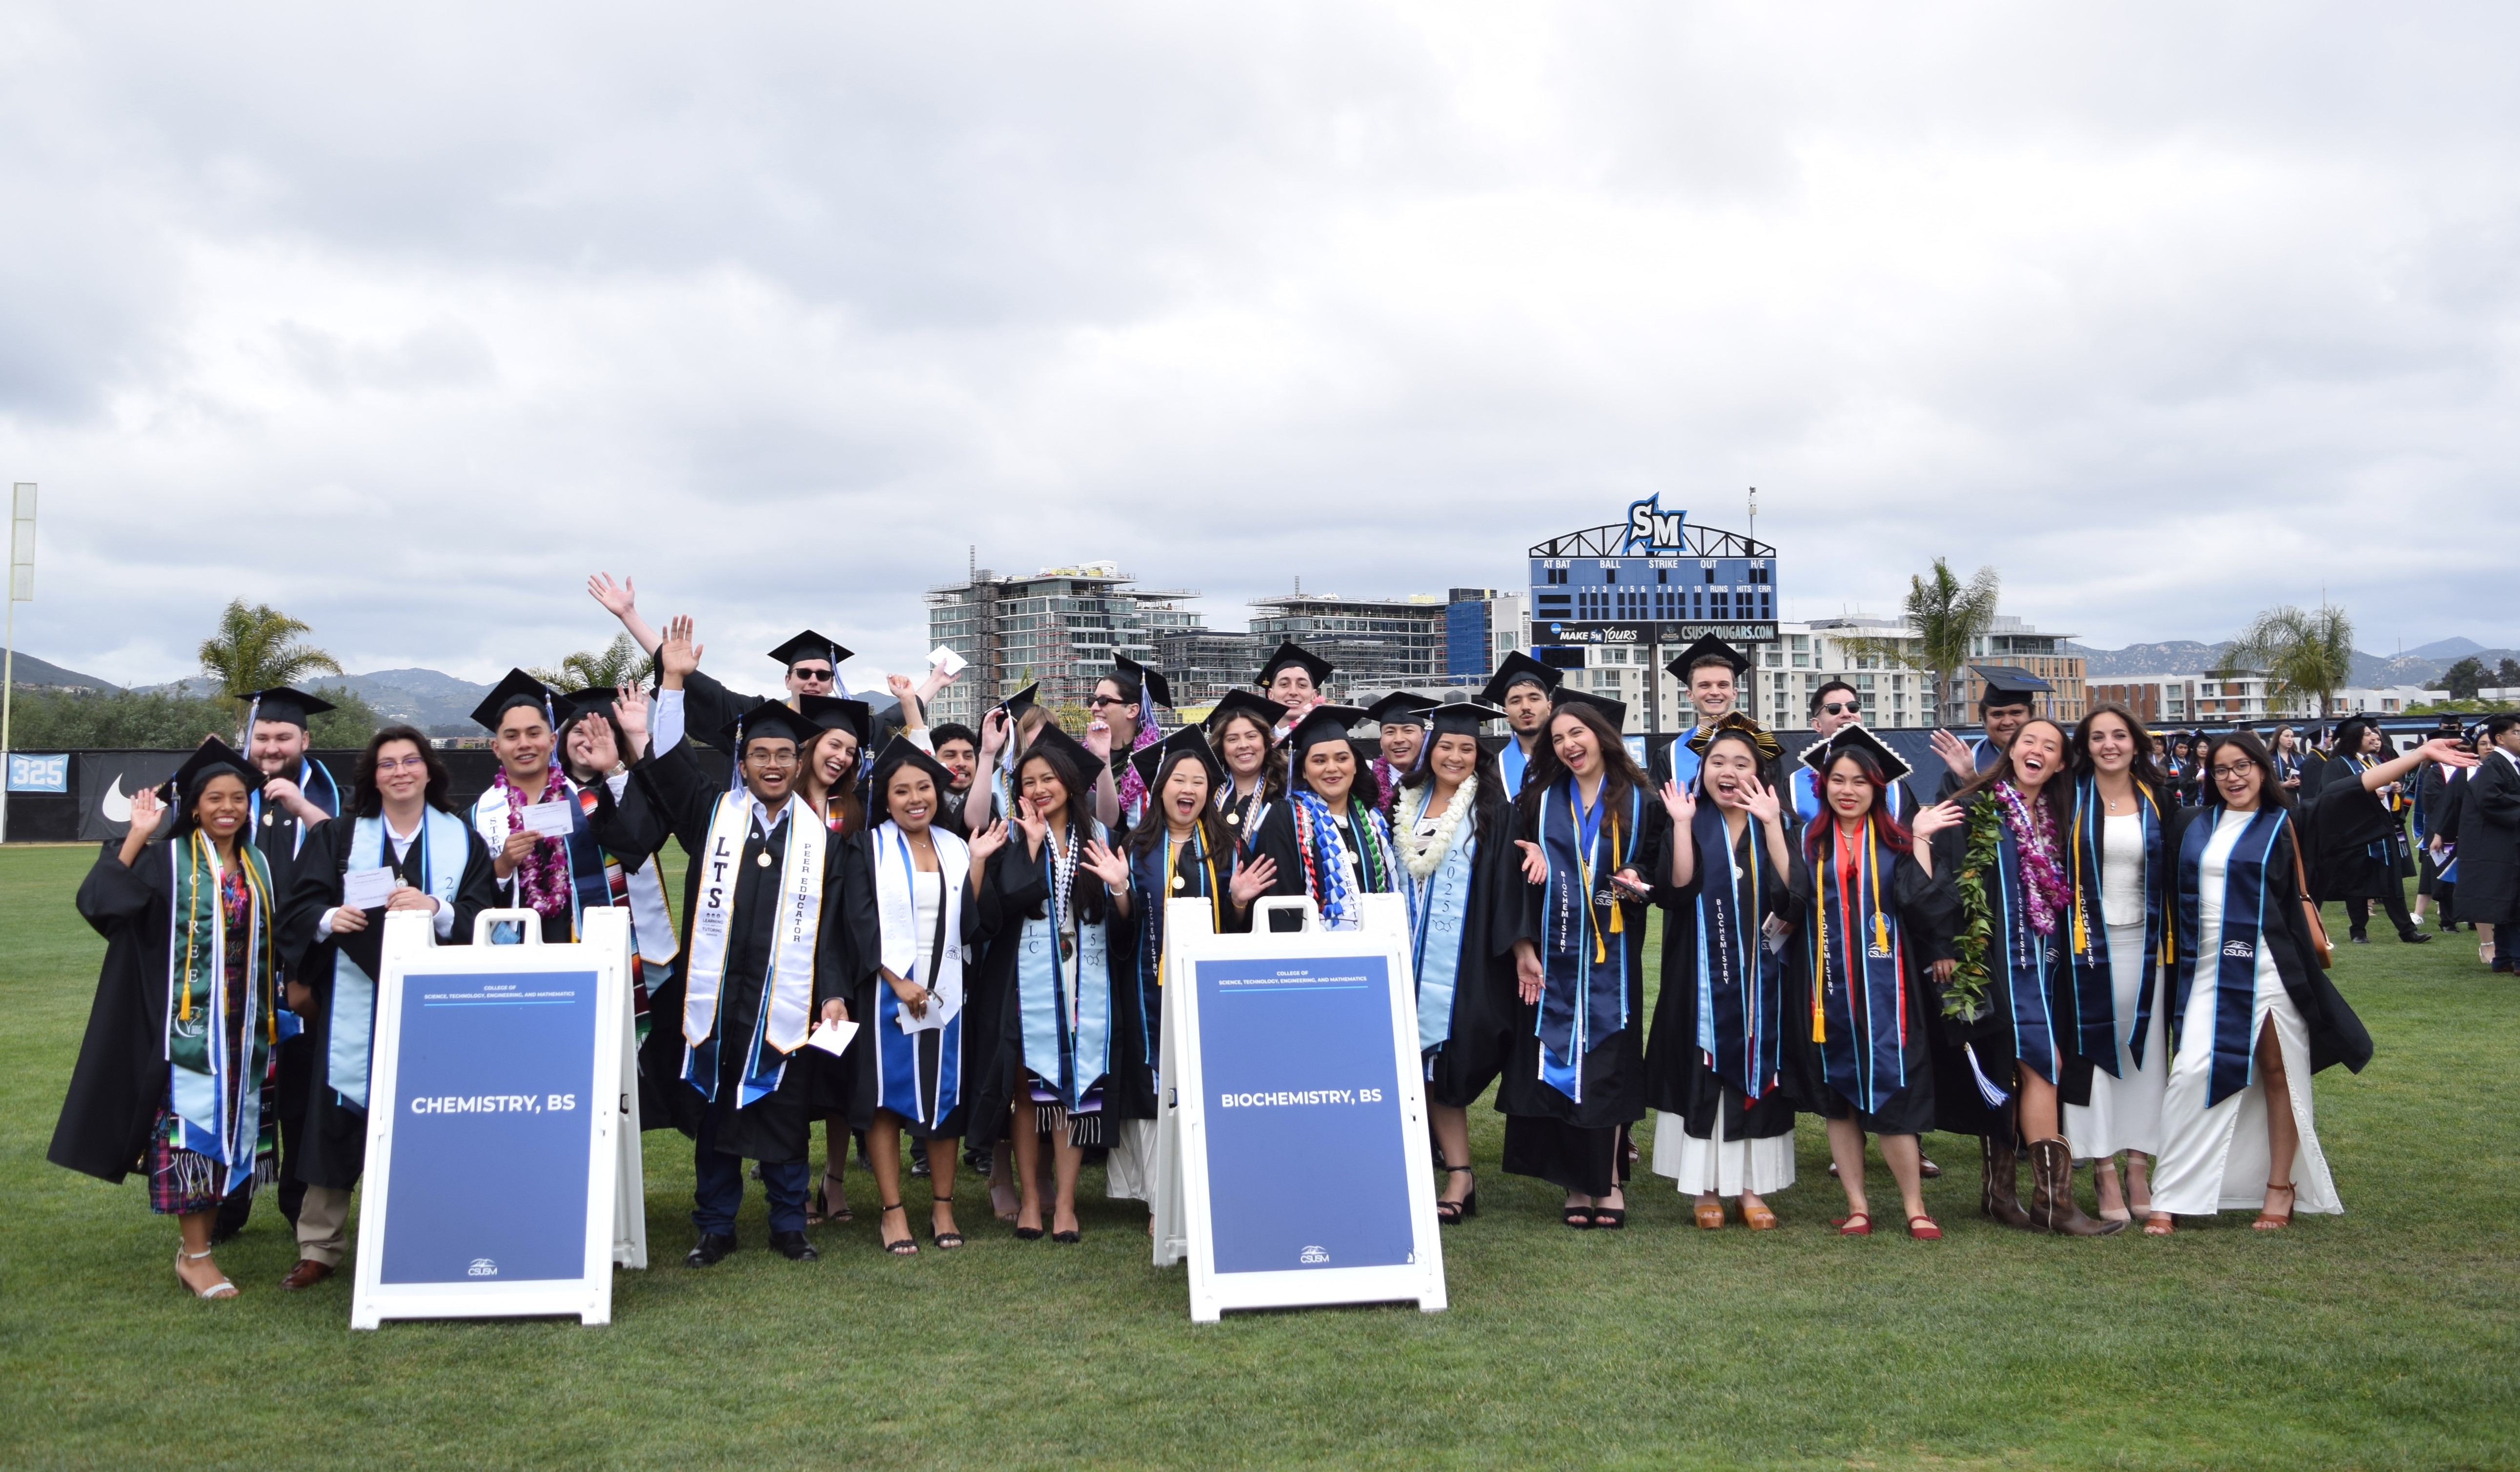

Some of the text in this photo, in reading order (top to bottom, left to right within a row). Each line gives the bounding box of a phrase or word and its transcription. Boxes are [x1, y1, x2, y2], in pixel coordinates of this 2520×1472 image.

[1544, 560, 1571, 568] AT BAT
[1600, 560, 1621, 568] BALL
[1648, 560, 1678, 568] STRIKE
[1700, 560, 1717, 568] OUT
[1751, 560, 1764, 569] H/E
[1560, 632, 1589, 640] MAKE
[865, 751, 874, 759] 25
[13, 759, 63, 785] 325
[490, 817, 502, 856] STEM
[708, 837, 731, 908] LTS
[1442, 850, 1458, 912] 2025
[793, 843, 811, 942] PEER EDUCATOR
[1560, 871, 1569, 953] BIOCHEMISTRY
[1147, 892, 1158, 977] BIOCHEMISTRY
[2016, 883, 2027, 970] BIOCHEMISTRY
[2079, 885, 2094, 969] BIOCHEMISTRY
[1716, 899, 1729, 984] BIOCHEMISTRY
[2223, 948, 2253, 958] CSUSM
[411, 1094, 576, 1114] CHEMISTRY, BS
[1221, 1089, 1382, 1107] BIOCHEMISTRY, BS
[1301, 1254, 1329, 1263] CSUSM
